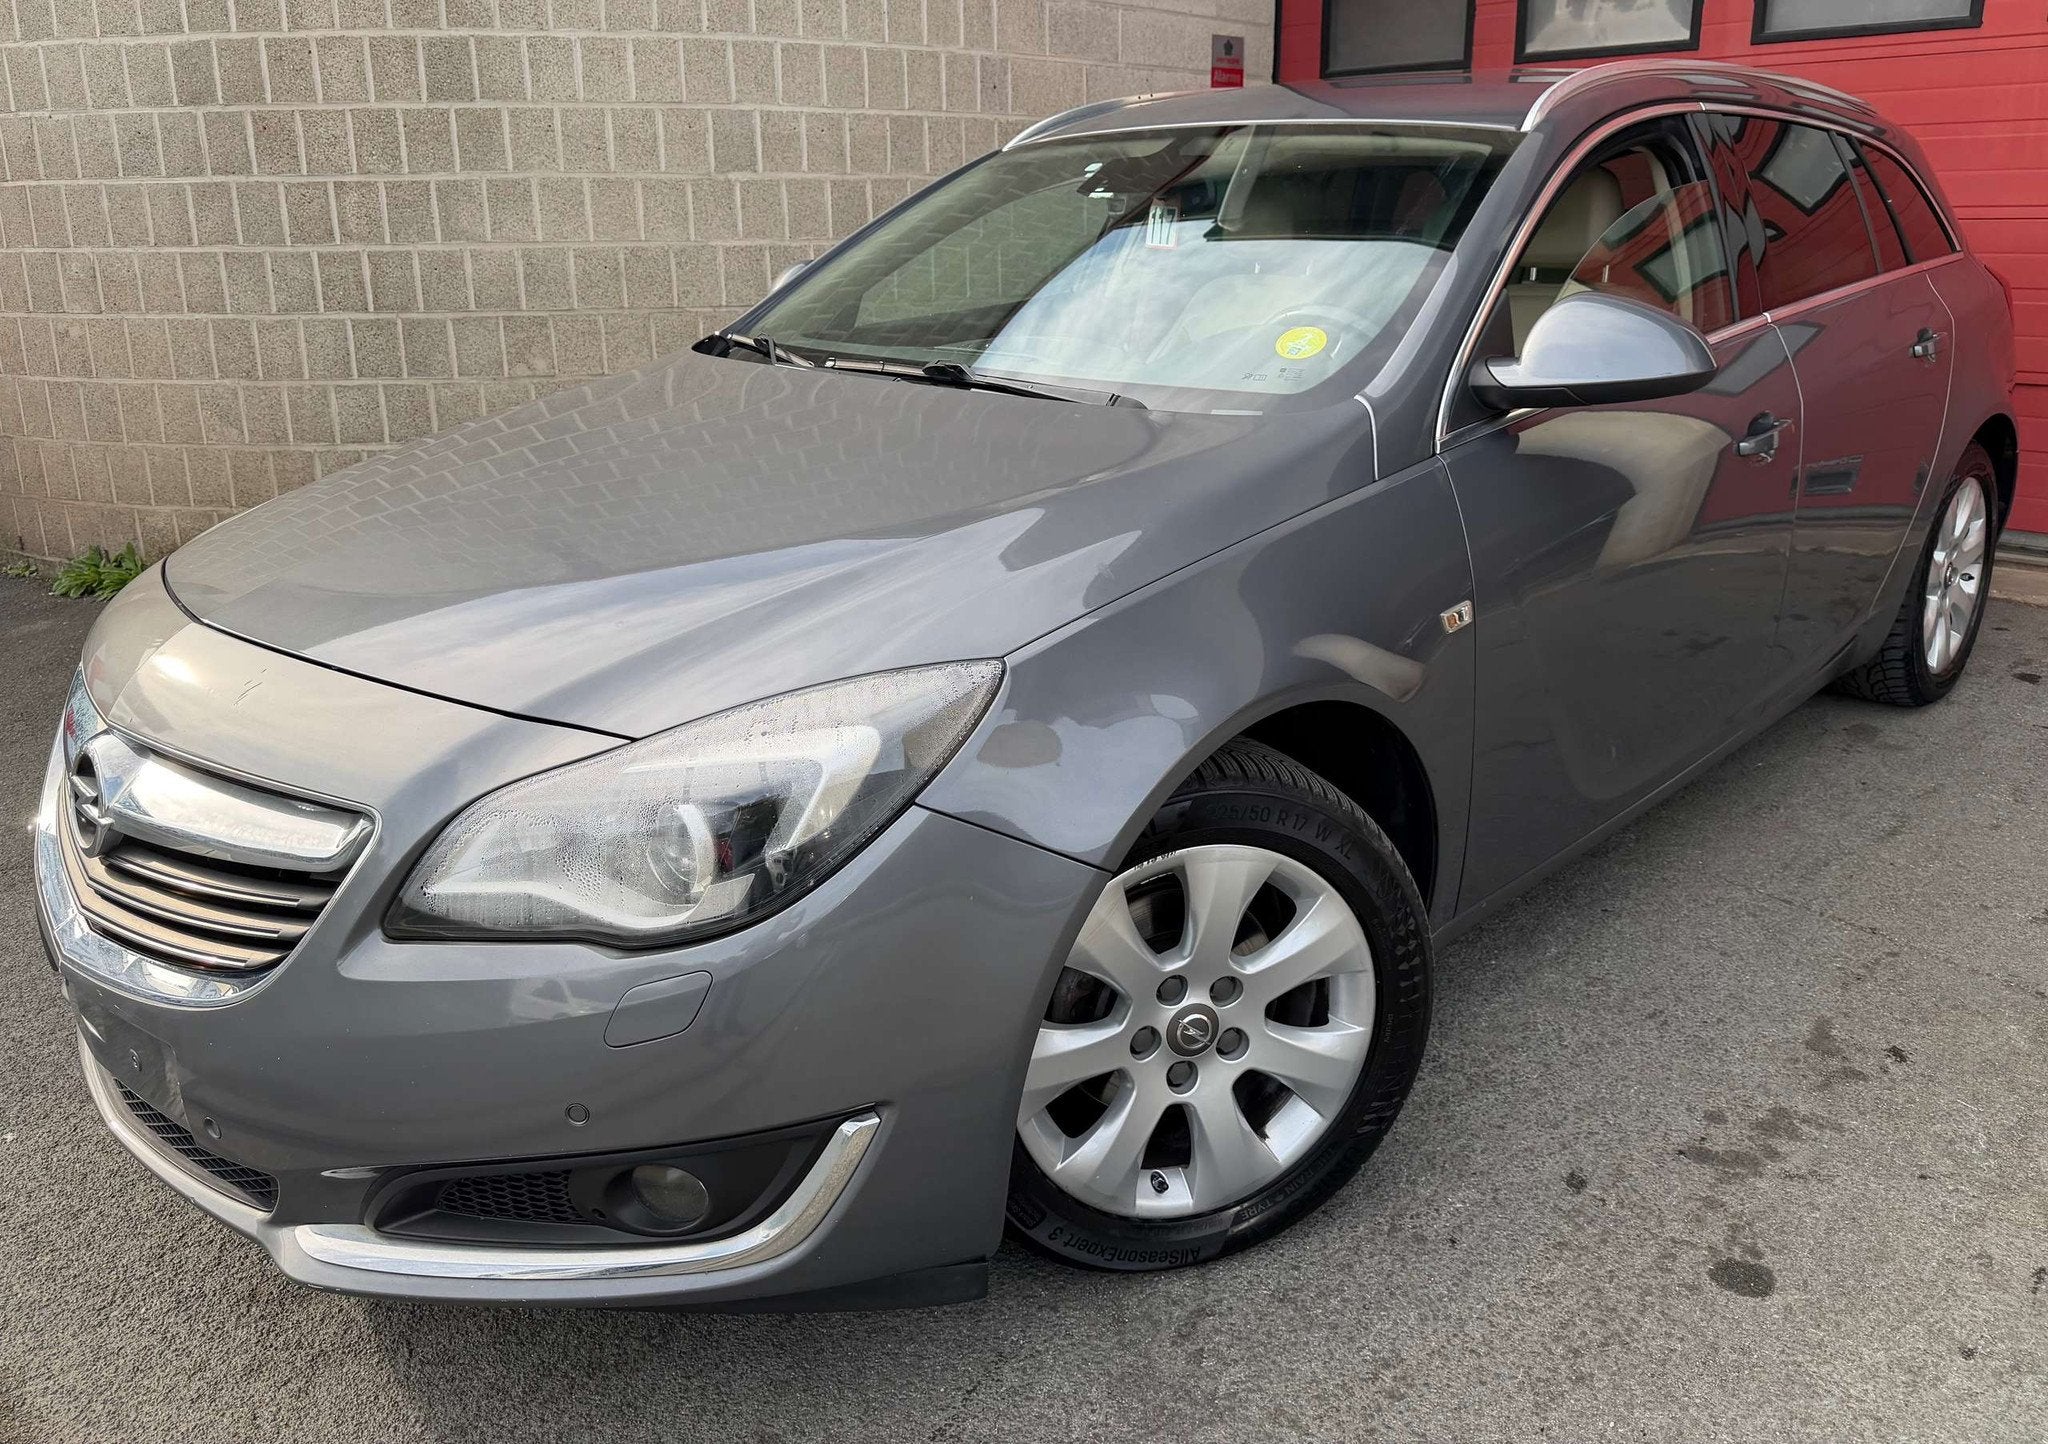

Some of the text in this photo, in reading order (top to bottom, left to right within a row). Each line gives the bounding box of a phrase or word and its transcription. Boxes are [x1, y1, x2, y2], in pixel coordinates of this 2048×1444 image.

[1275, 809, 1287, 827] R
[1291, 813, 1309, 833] 17
[1314, 822, 1332, 842] W
[1333, 838, 1353, 861] XL
[1239, 1195, 1274, 1222] TYRE
[1047, 1225, 1201, 1266] AllSeasonExpert 3
